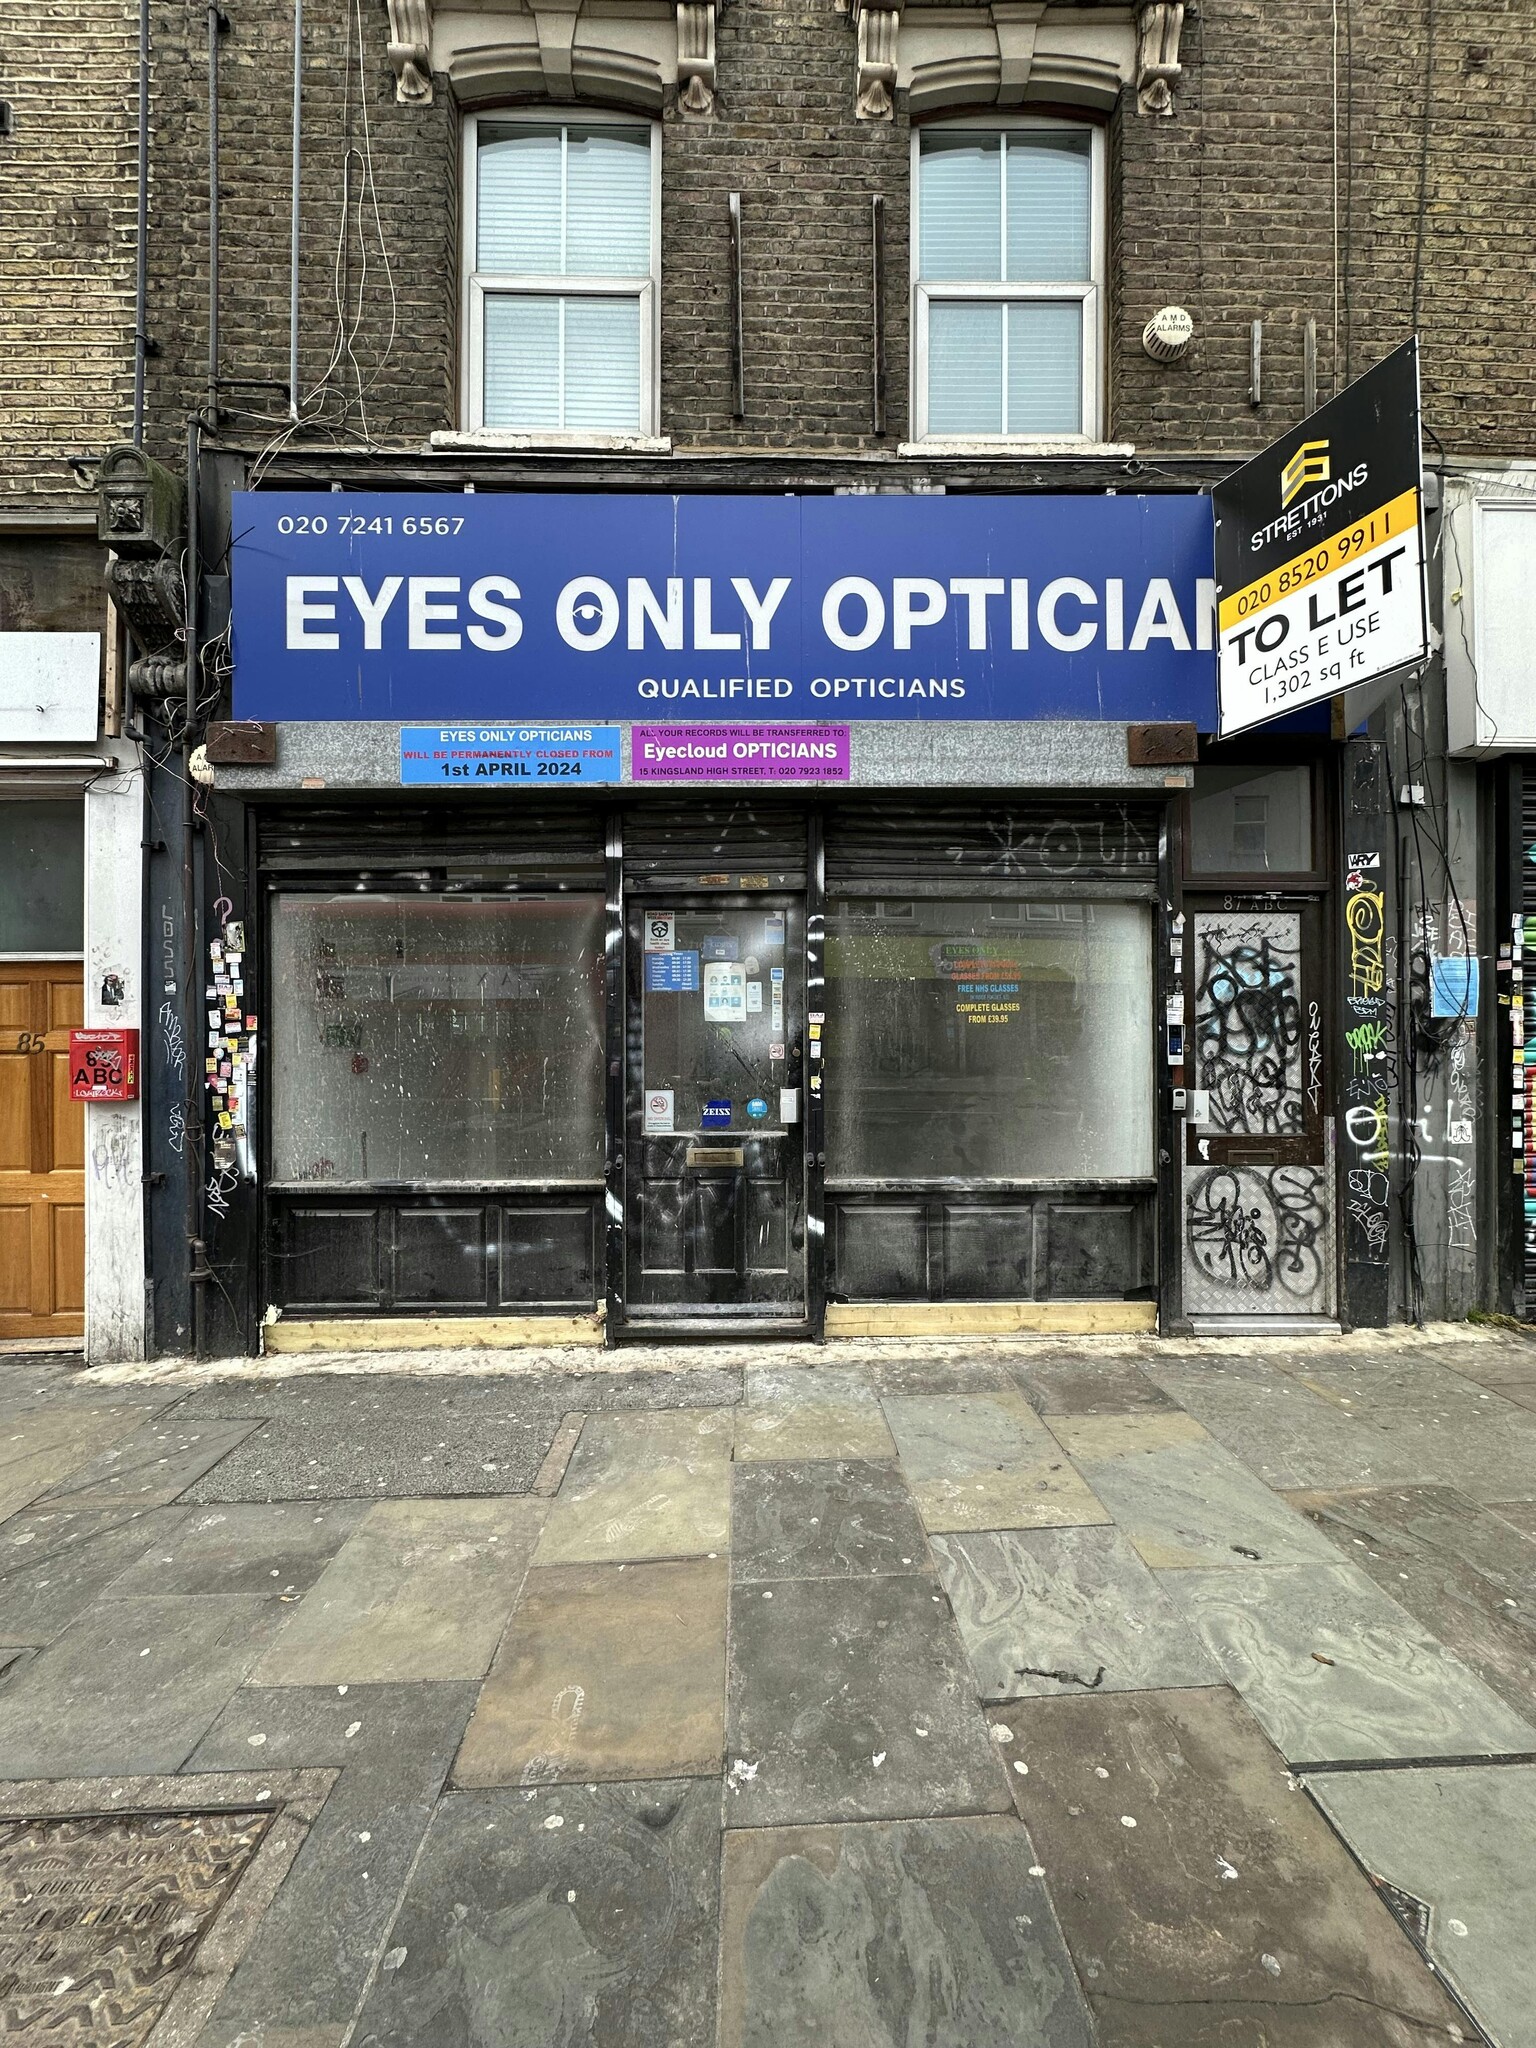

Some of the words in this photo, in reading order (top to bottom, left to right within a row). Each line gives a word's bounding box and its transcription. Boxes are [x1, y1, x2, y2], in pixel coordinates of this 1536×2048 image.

[1156, 324, 1190, 332] ALARMS
[1250, 463, 1368, 551] STRETTONS
[277, 516, 328, 535] 020
[338, 516, 392, 536] 7241
[402, 517, 465, 536] 6567
[1286, 527, 1303, 541] EST
[1307, 511, 1328, 529] 1931
[1237, 586, 1271, 616] 020
[1279, 550, 1329, 593] 8520
[1338, 512, 1391, 560] 9911
[286, 575, 523, 652] EYES
[555, 575, 791, 652] ONLY
[821, 575, 1214, 652] OPTICIA
[1228, 613, 1290, 667] TO
[1309, 545, 1406, 632] LET
[1249, 652, 1309, 686] CLASS
[1318, 635, 1329, 656] E
[1338, 611, 1382, 646] USE
[1264, 671, 1312, 704] 1,302
[1320, 661, 1342, 680] sq
[1349, 649, 1366, 668] ft
[637, 678, 793, 700] QUALIFIED
[810, 678, 966, 698] OPTICIANS
[440, 730, 476, 742] EYES
[479, 730, 516, 742] ONLY
[519, 730, 593, 742] OPTICIANS
[639, 729, 657, 737] ALL
[658, 729, 683, 737] YOUR
[685, 729, 728, 737] RECORDS
[729, 729, 751, 737] WILL
[752, 729, 765, 737] BE
[766, 729, 831, 737] TRANSFERRED
[832, 729, 847, 737] TO:
[403, 751, 430, 759] WILL
[433, 751, 448, 759] BE
[451, 750, 532, 759] PERMANENTLY
[536, 750, 580, 758] CLOSED
[583, 750, 614, 758] FROM
[644, 742, 728, 762] Eyecloud
[732, 742, 838, 759] OPTICIANS
[441, 763, 470, 776] 1st
[475, 763, 532, 776] APRIL
[537, 762, 582, 776] 2024
[651, 767, 704, 775] KINGSLAND
[706, 767, 729, 775] HIGH
[731, 767, 767, 776] STREET,
[769, 767, 777, 775] T:
[778, 767, 797, 775] 020
[798, 767, 821, 775] 7923
[823, 767, 844, 775] 1852
[946, 946, 970, 955] EYES
[957, 984, 974, 993] FREE
[975, 984, 989, 992] NHS
[990, 984, 1019, 992] GLASSES
[956, 1003, 990, 1012] COMPLETE
[991, 1003, 1020, 1012] GLASSES
[968, 1015, 987, 1024] FROM
[988, 1014, 1009, 1023] £39.95
[17, 1032, 46, 1055] 85
[702, 1107, 731, 1116] ZEISS
